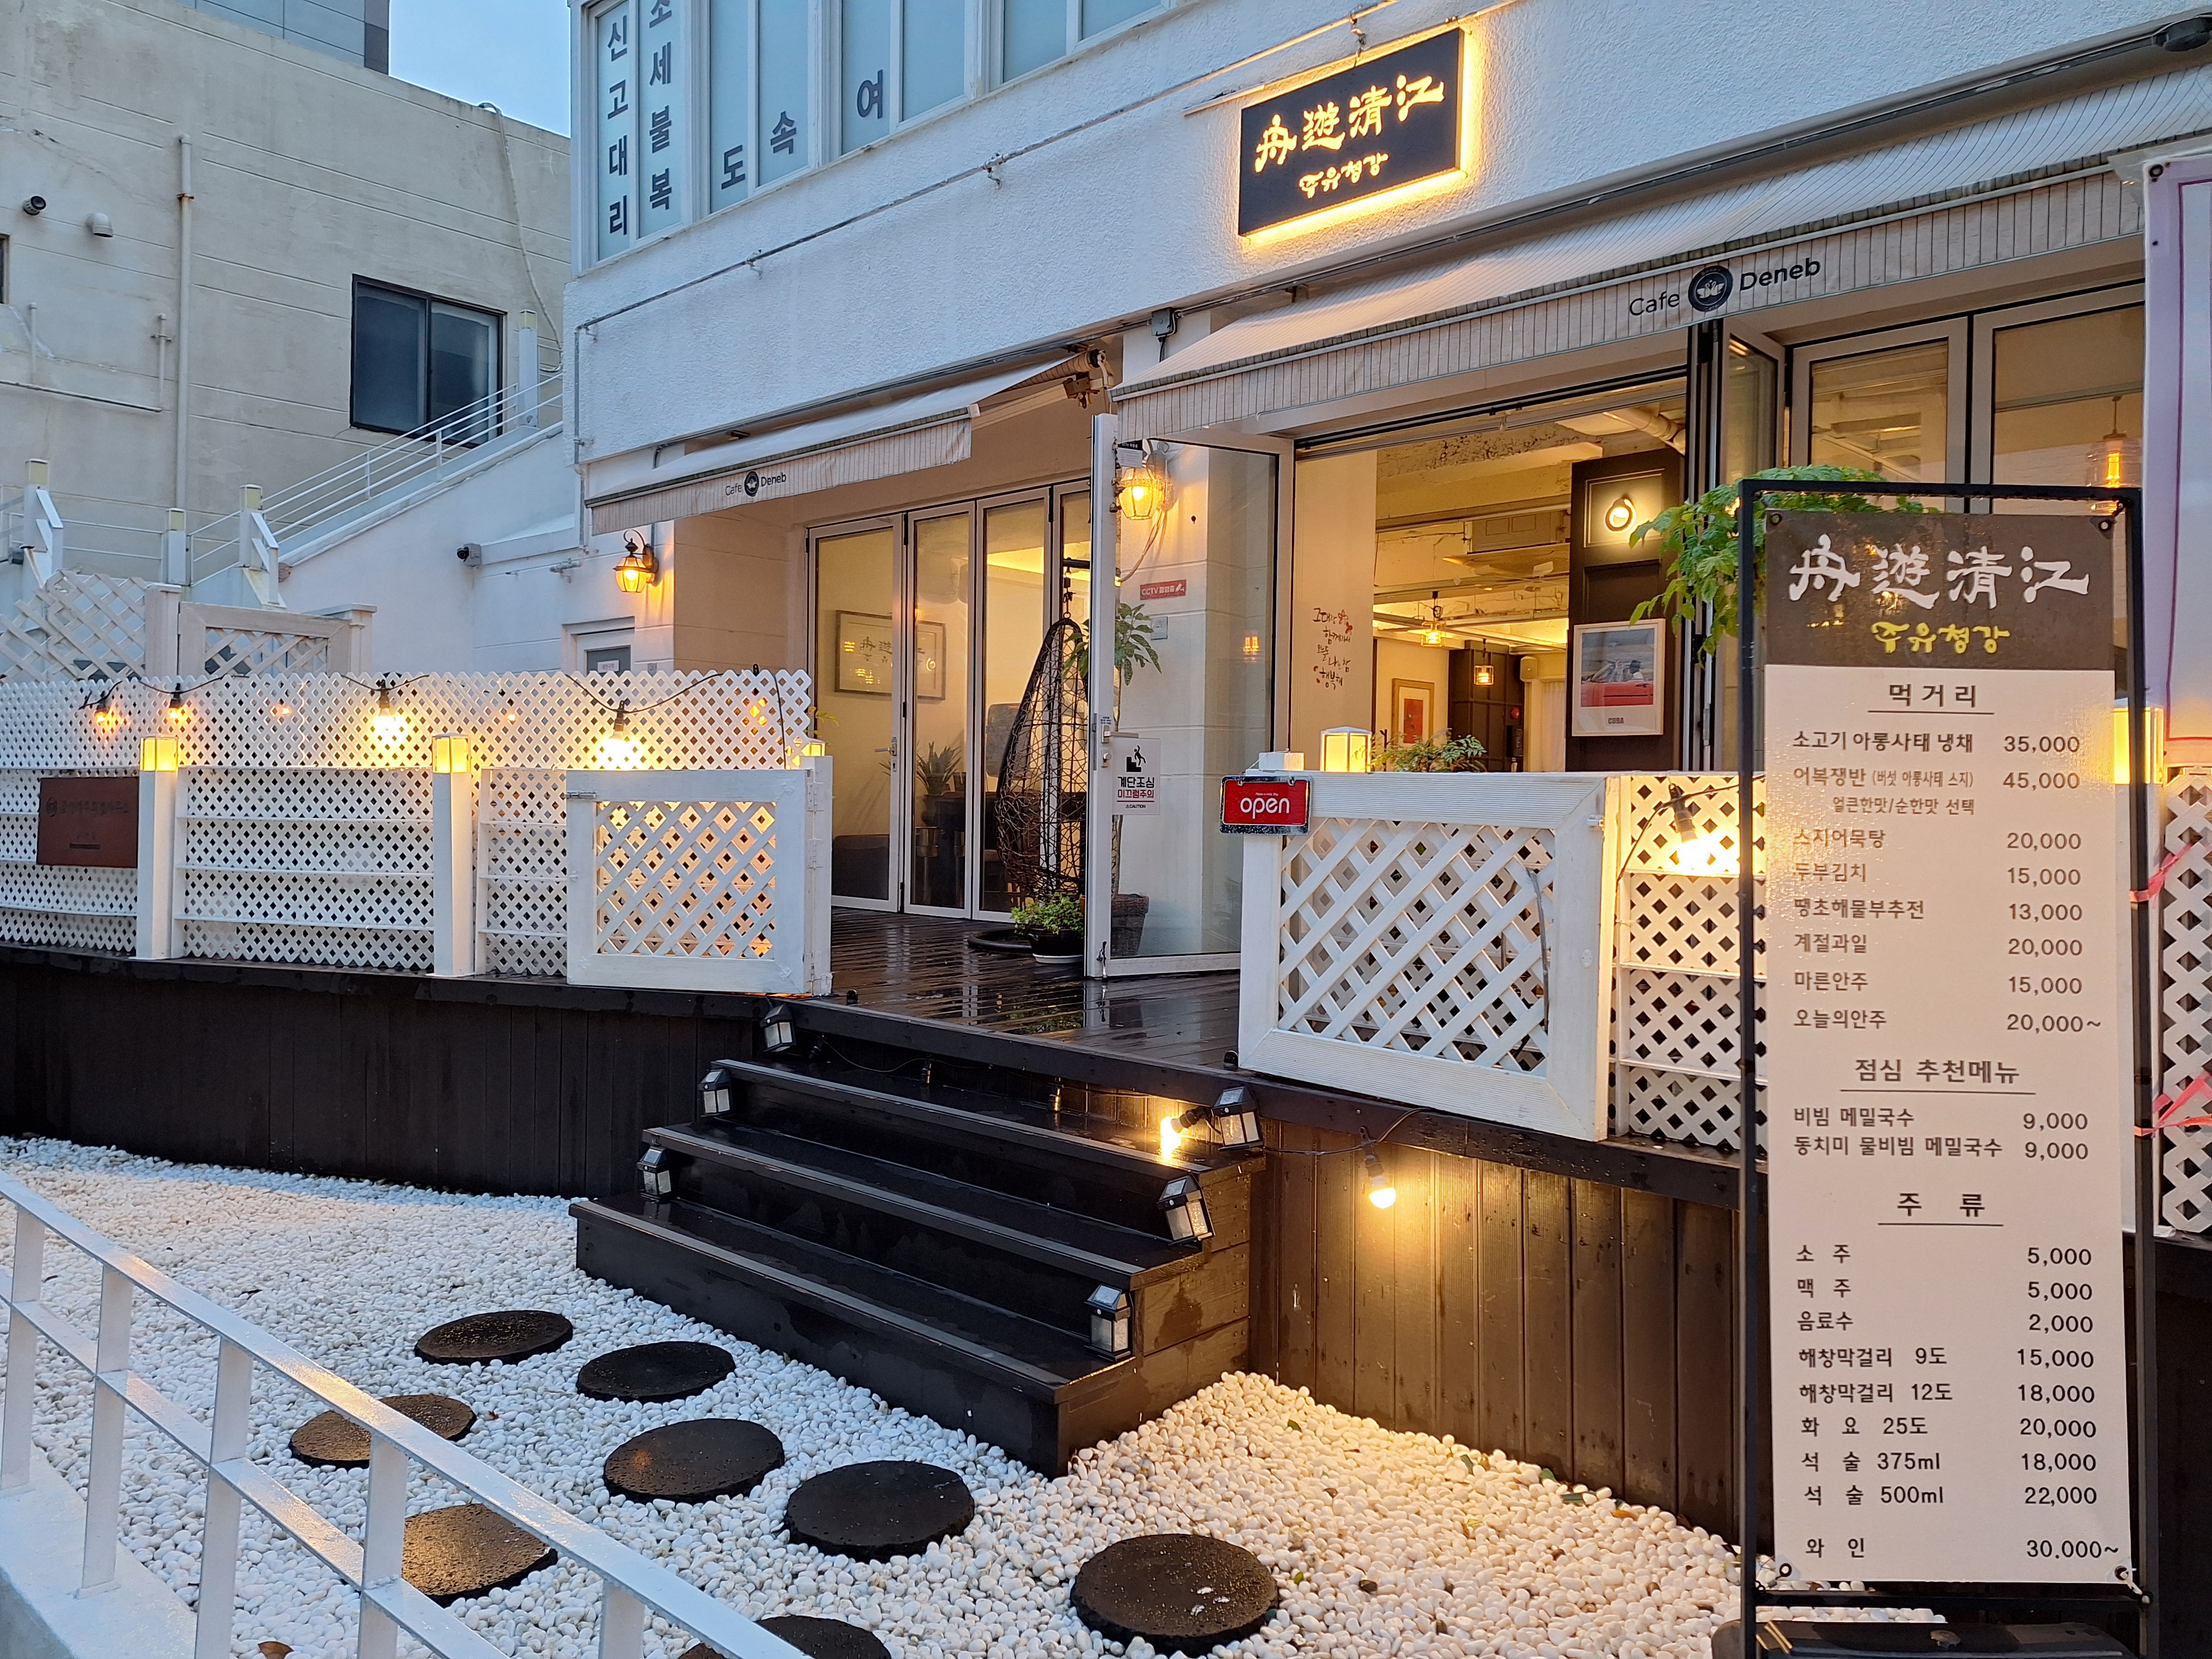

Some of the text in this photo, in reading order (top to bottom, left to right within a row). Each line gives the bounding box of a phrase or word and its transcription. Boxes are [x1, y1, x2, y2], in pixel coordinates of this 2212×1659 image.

[857, 69, 883, 119] 여
[607, 15, 628, 235] 신고대리
[770, 111, 796, 155] 속
[721, 144, 746, 190] 도
[1299, 152, 1389, 199] 주유청강
[1629, 258, 1821, 316] Cafe Deneb
[725, 472, 787, 496] Cafe Deneb
[1870, 621, 2011, 654] 주유청강
[1792, 731, 1973, 753] 소고기 아롱사태 냉채
[2004, 736, 2080, 753] 35,000
[1117, 776, 1155, 788] 계단조심
[1793, 767, 1973, 788] 어복쟁반 (버섯 아롱사태 스지)
[2003, 772, 2080, 791] 45,000
[1117, 789, 1154, 798] 미끄럼주의
[1240, 798, 1290, 819] open
[1832, 796, 1975, 815] 얼큰한맛/순한맛 선택
[2007, 833, 2081, 851] 20,000
[1793, 863, 1866, 883] 두부김치
[2008, 867, 2081, 887] 15,000
[1793, 898, 1925, 919] 땡초해물부추전
[2008, 903, 2082, 923] 13,000
[1793, 933, 1867, 954] 계절과일
[2008, 938, 2082, 958] 20,000
[1793, 971, 1869, 992] 마른안주
[2008, 976, 2082, 996] 15,000
[1793, 1009, 1887, 1030] 오늘의안주
[2007, 1014, 2101, 1034] 20,000~
[1855, 1059, 2020, 1084] 점심 추천메뉴
[1793, 1107, 1914, 1127] 비빔 메밀국수
[2023, 1113, 2088, 1131] 9,000
[1793, 1136, 2003, 1158] 동치미 물비빔 메밀국수
[2024, 1142, 2088, 1161] 9,000
[2027, 1247, 2092, 1266] 5,000
[2028, 1281, 2093, 1301] 5,000
[1797, 1311, 1854, 1331] 음료수
[2028, 1314, 2094, 1334] 2,000
[1798, 1347, 1947, 1368] 해창막걸리 9도
[2017, 1348, 2094, 1368] 15,000
[1799, 1383, 1953, 1404] 해창막걸리 12도
[2017, 1384, 2095, 1404] 18,000
[1882, 1417, 1928, 1435] 25도
[2020, 1418, 2097, 1439] 20,000
[1877, 1452, 1940, 1471] 375ml
[2021, 1452, 2097, 1473] 18,000
[1880, 1486, 1944, 1504] 500ml
[2024, 1487, 2097, 1507] 22,000
